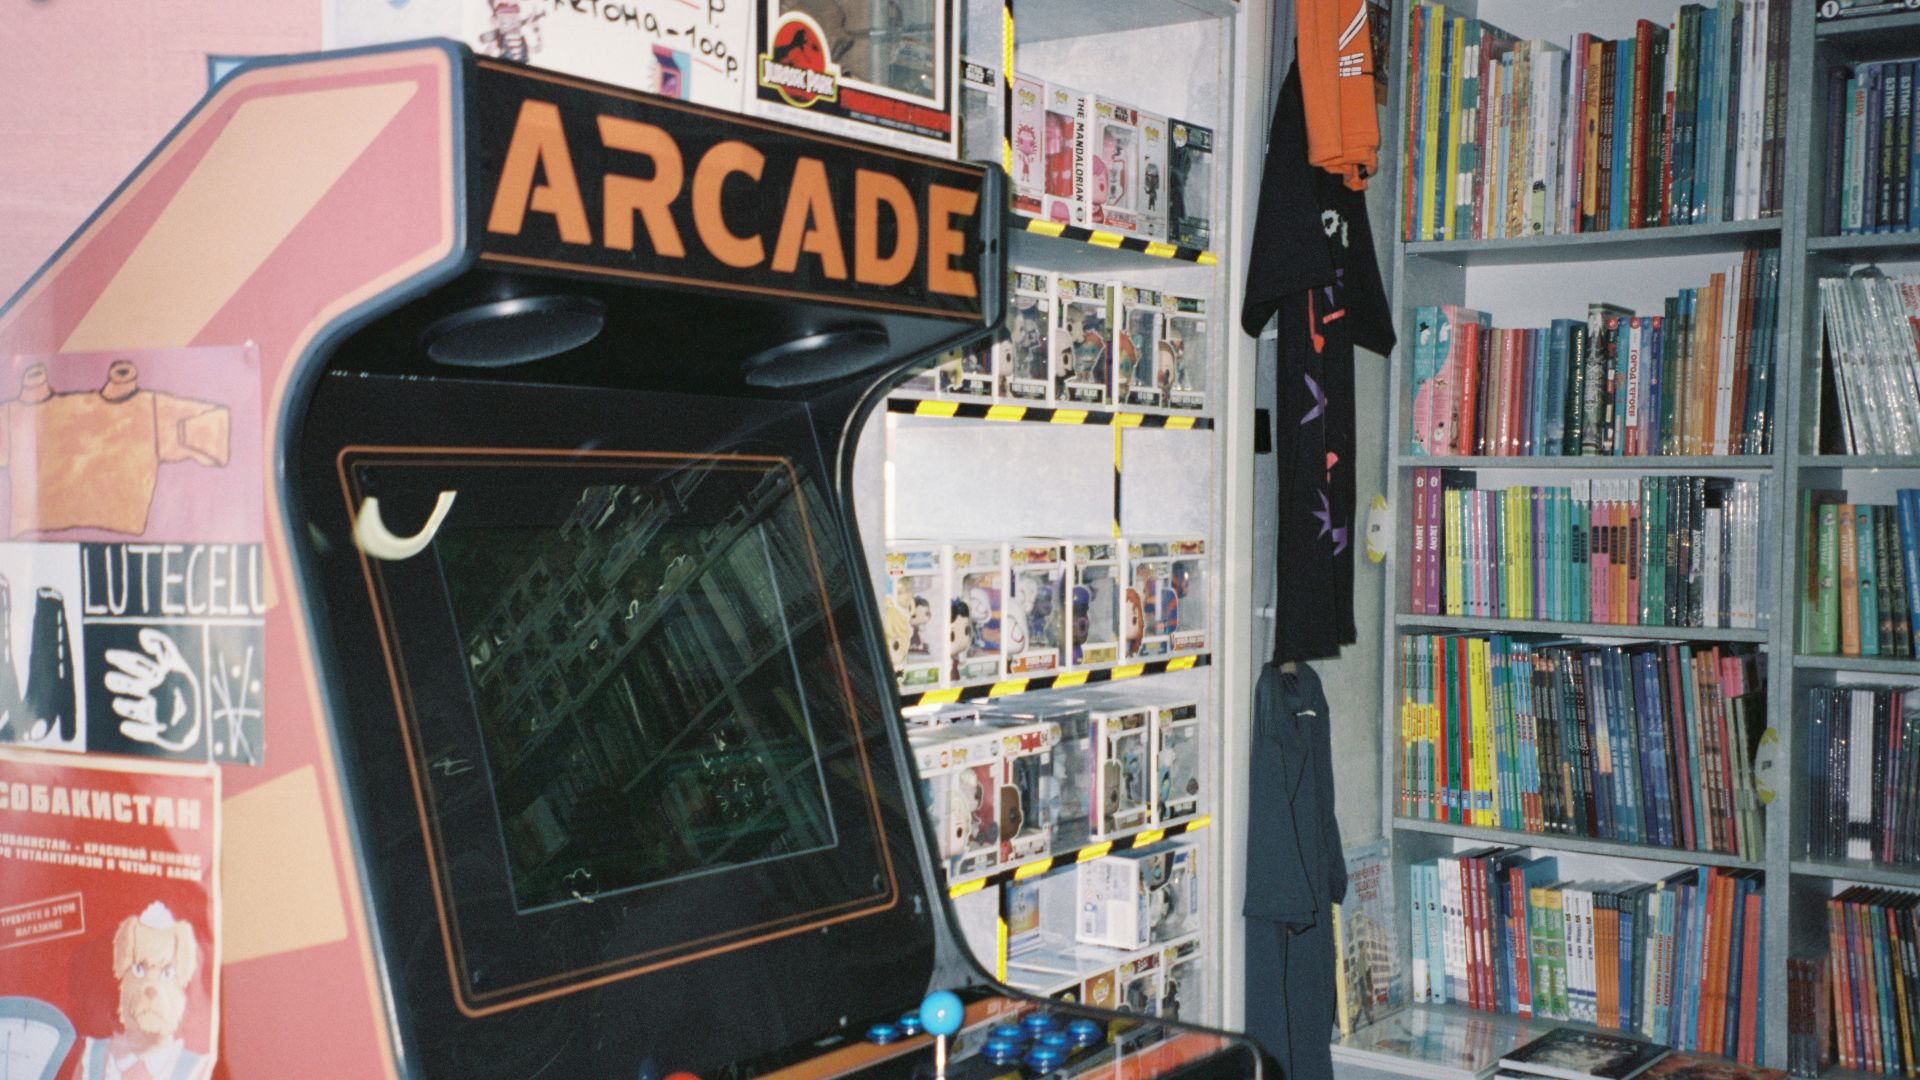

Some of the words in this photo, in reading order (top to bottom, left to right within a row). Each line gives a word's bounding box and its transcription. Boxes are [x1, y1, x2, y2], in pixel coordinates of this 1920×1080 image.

[1076, 97, 1086, 120] THE
[1884, 77, 1895, 117] БЭТМЕН
[1899, 76, 1911, 116] БЭТМЕН
[1073, 122, 1085, 203] MANDALORIAN
[487, 98, 981, 299] ARCADE
[1629, 349, 1639, 380] ГОРОД
[1628, 381, 1638, 417] ГЕРОЕВ
[0, 781, 201, 830] СОБАКИСТАН
[15, 848, 103, 870] ТОТАЛИТАРИЗМ
[106, 859, 115, 871] И
[118, 860, 163, 877] ЧЕТЫРЕ
[83, 842, 147, 862] КРАСИВЫЙ
